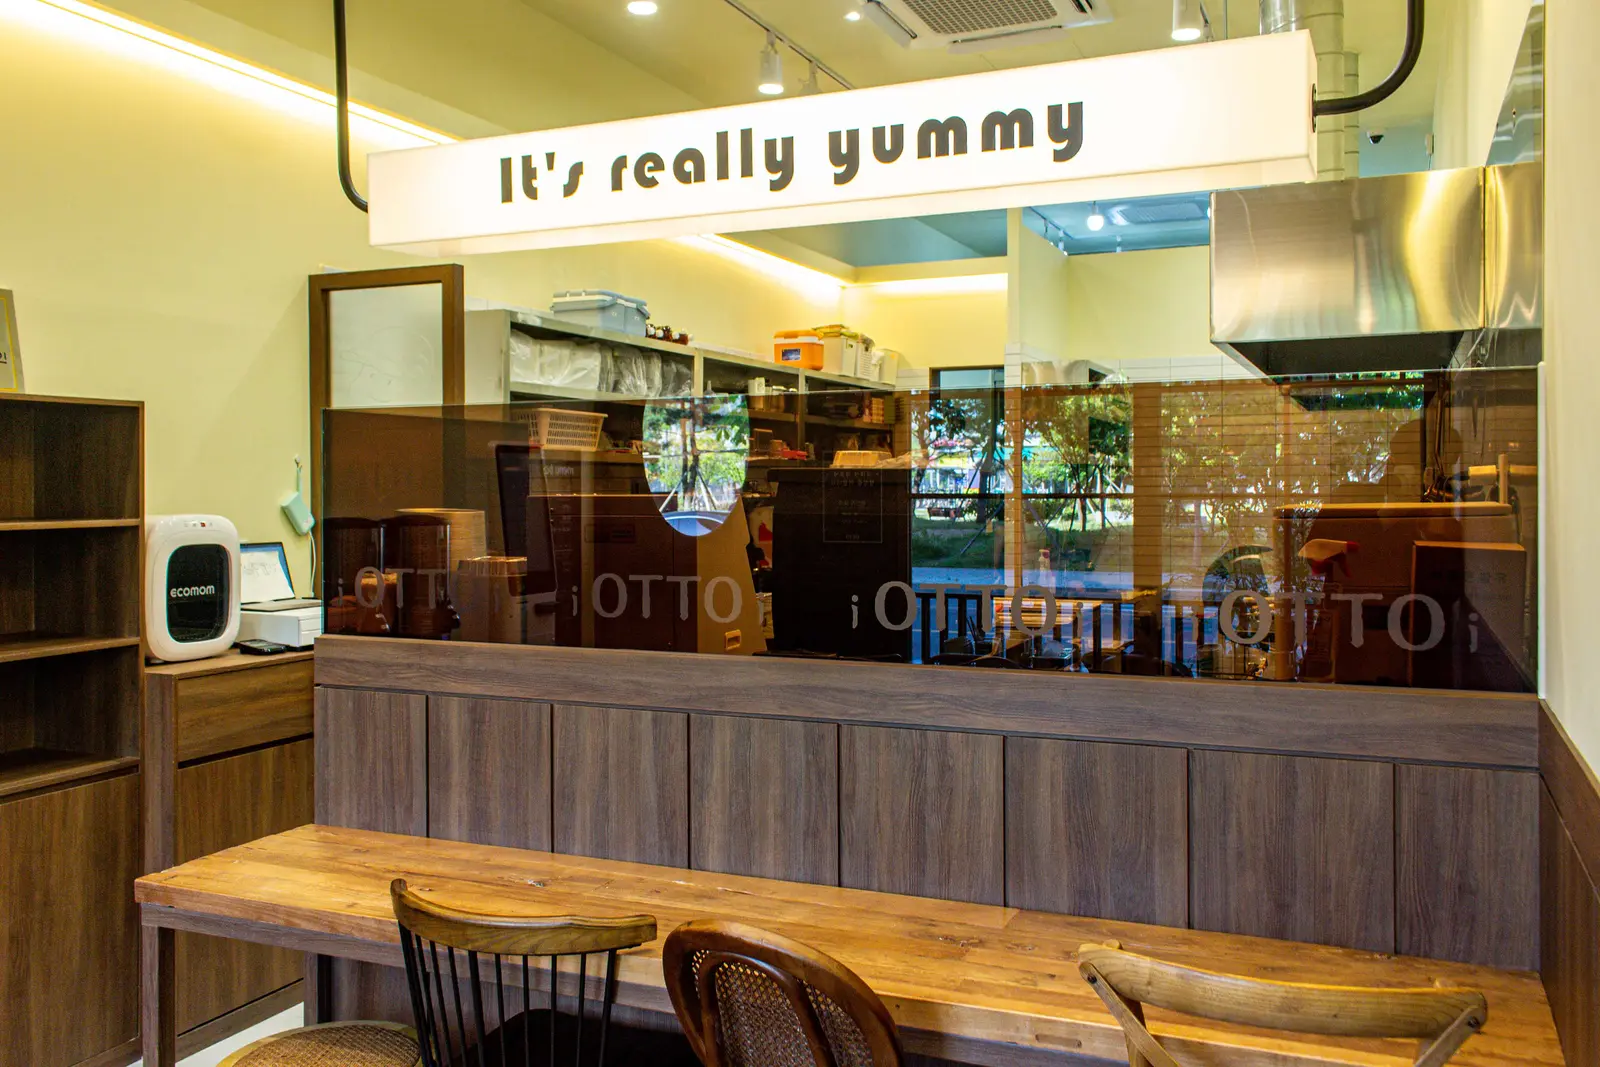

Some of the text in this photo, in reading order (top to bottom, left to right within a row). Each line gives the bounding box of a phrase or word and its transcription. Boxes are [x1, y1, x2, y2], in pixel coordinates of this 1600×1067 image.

[500, 101, 1083, 204] It's really yummy
[169, 584, 216, 598] ecomom
